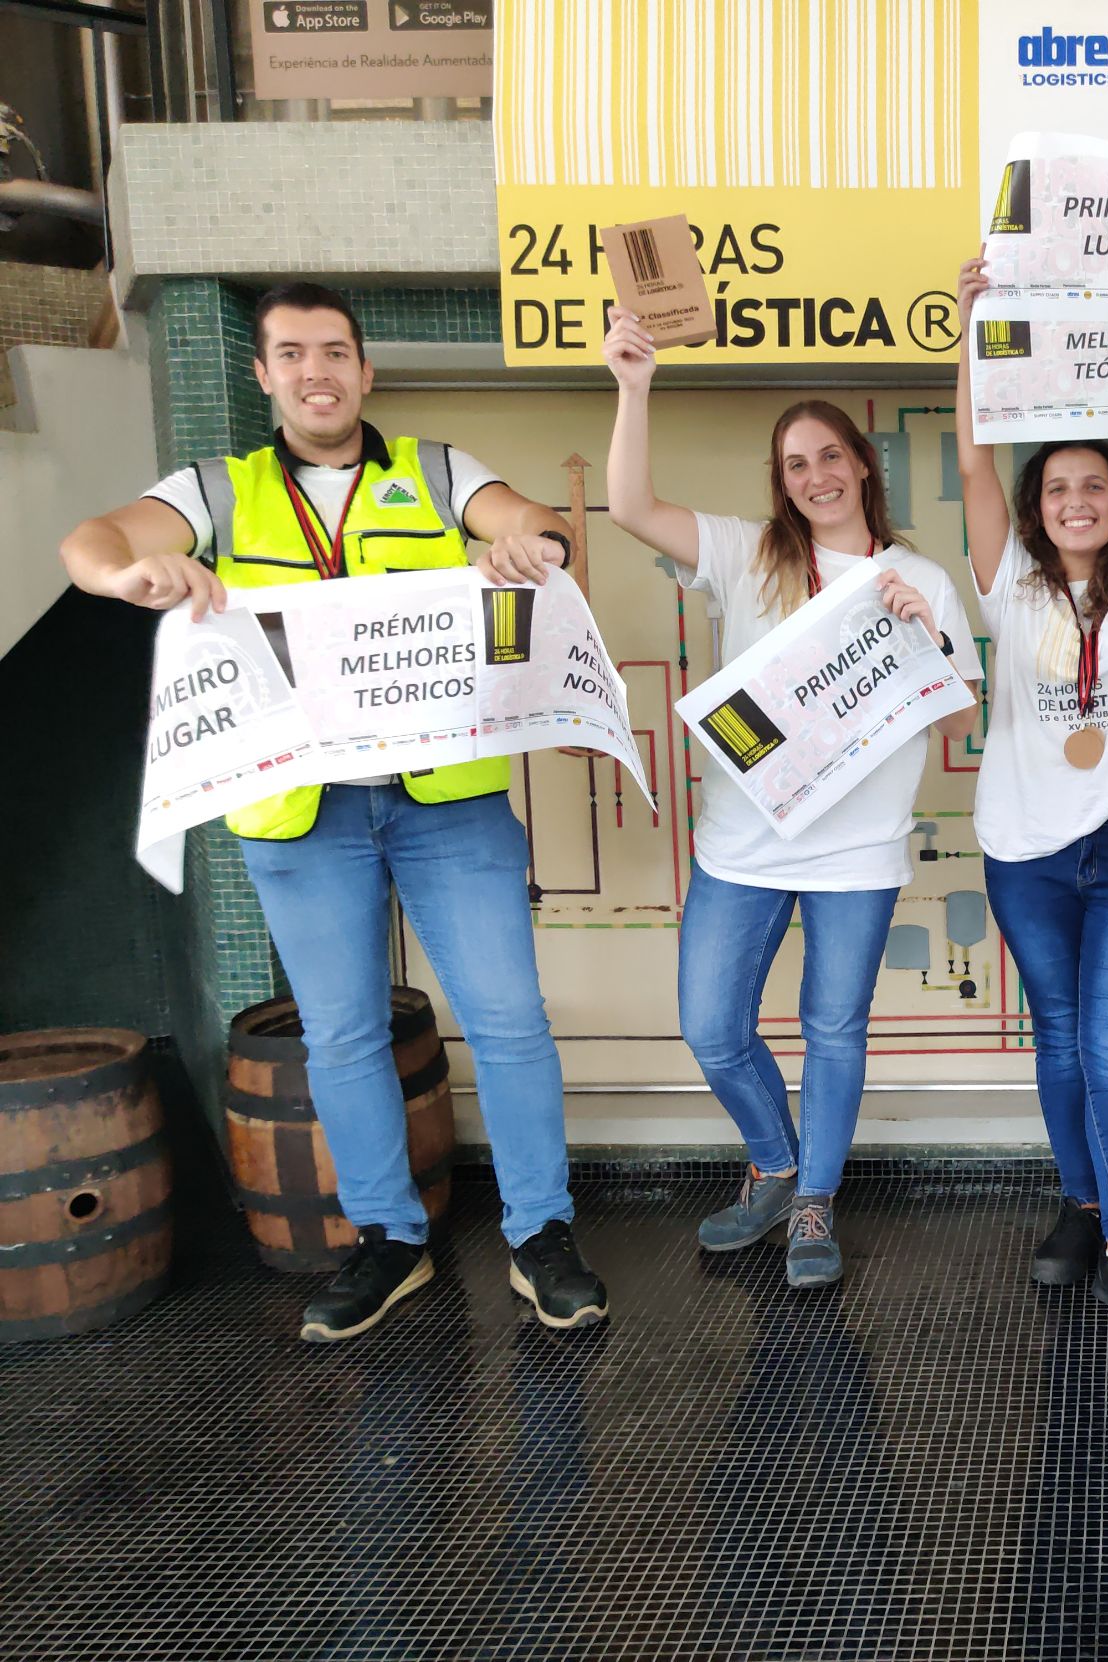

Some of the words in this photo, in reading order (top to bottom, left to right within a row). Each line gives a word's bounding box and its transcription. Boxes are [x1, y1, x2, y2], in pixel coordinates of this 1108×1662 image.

[296, 15, 323, 30] App
[325, 14, 360, 27] Store
[419, 12, 463, 27] Google
[464, 12, 488, 27] Play
[269, 54, 338, 71] Experiência
[342, 54, 357, 68] de
[360, 53, 419, 67] Realidade
[423, 53, 493, 67] Aumentada
[510, 223, 572, 275] 24
[516, 299, 586, 349] DE
[648, 305, 700, 320] Classificada
[353, 610, 454, 642] PRÉMIO
[340, 641, 475, 676] MELHORES
[794, 616, 893, 707] PRIMEIRO
[353, 675, 474, 709] TEÓRICOS
[832, 654, 899, 719] LUGAR
[1037, 682, 1052, 695] 24
[1038, 699, 1057, 712] DE
[1039, 714, 1051, 722] 15
[1063, 713, 1074, 721] 16
[150, 706, 236, 764] LUGAR
[1068, 723, 1081, 731] XV
